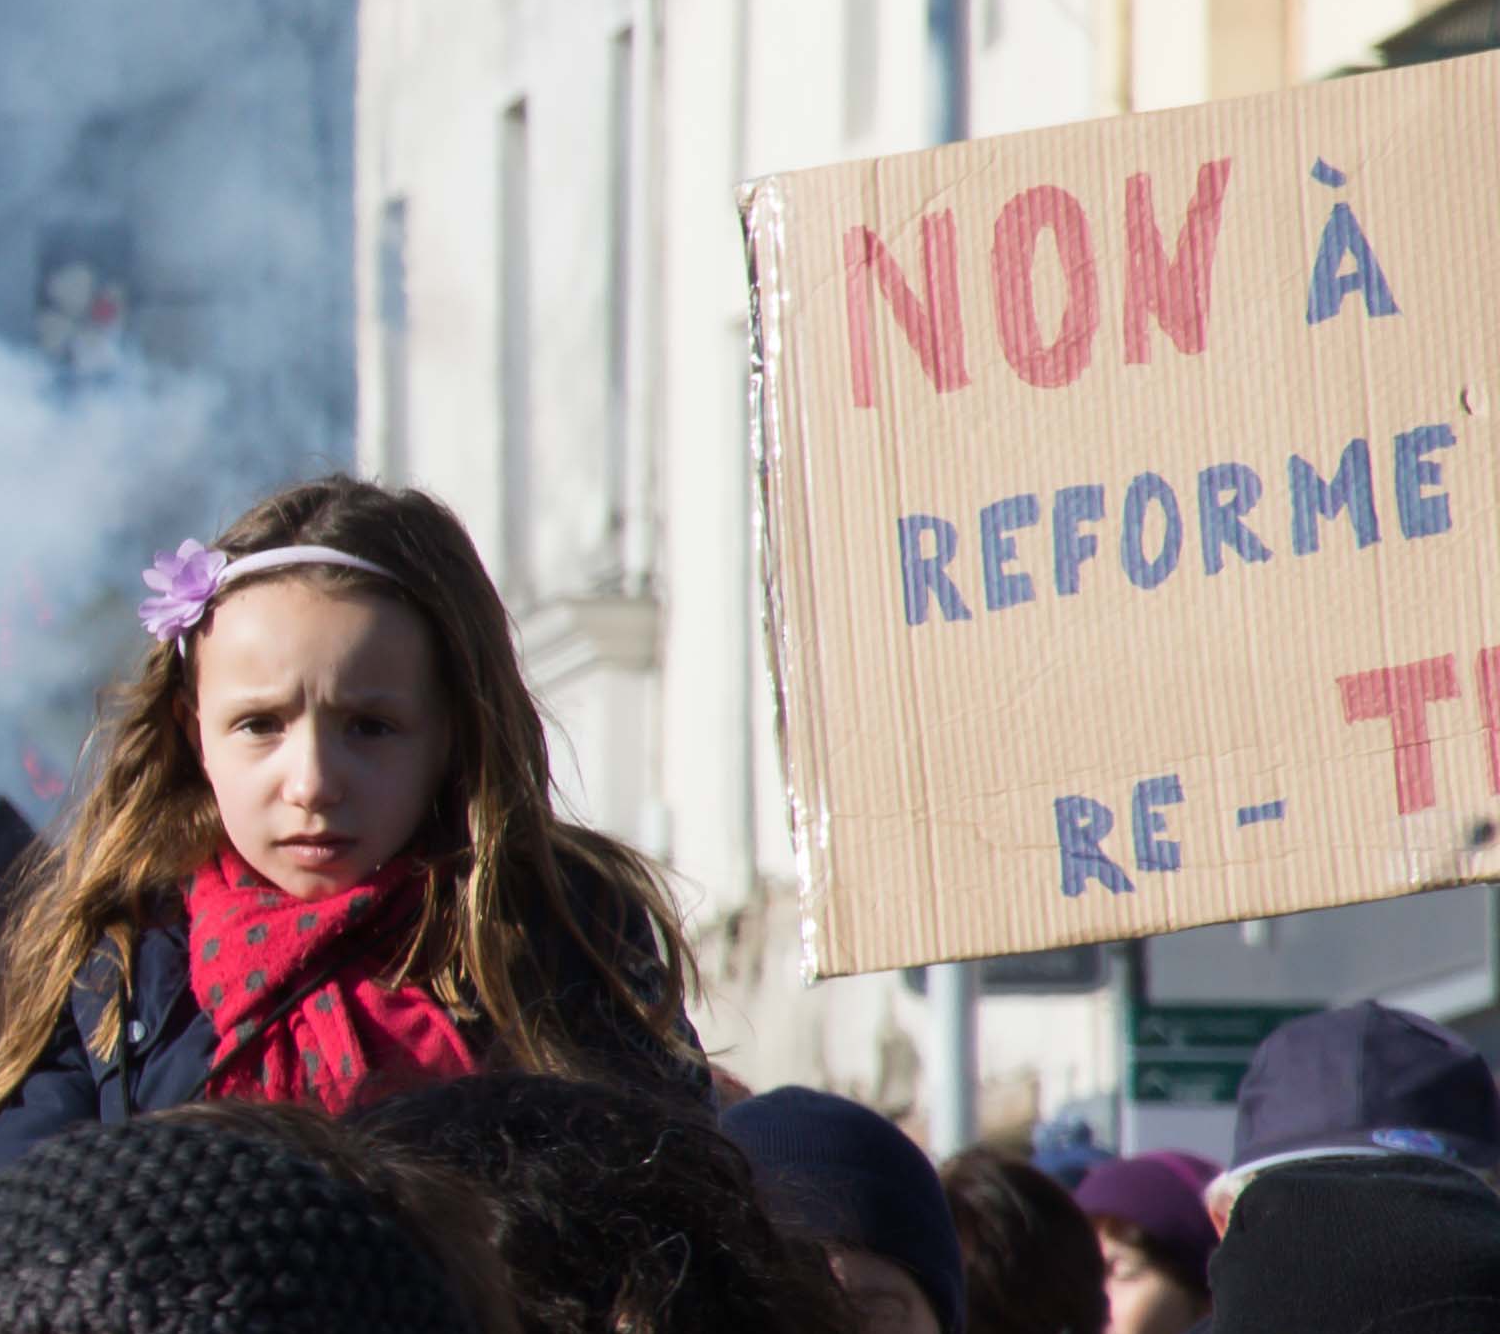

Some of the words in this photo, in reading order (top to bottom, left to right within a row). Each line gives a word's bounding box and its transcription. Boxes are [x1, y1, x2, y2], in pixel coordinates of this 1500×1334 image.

[843, 157, 1232, 409] NON
[1306, 157, 1401, 324] À
[900, 424, 1457, 627] REFORME
